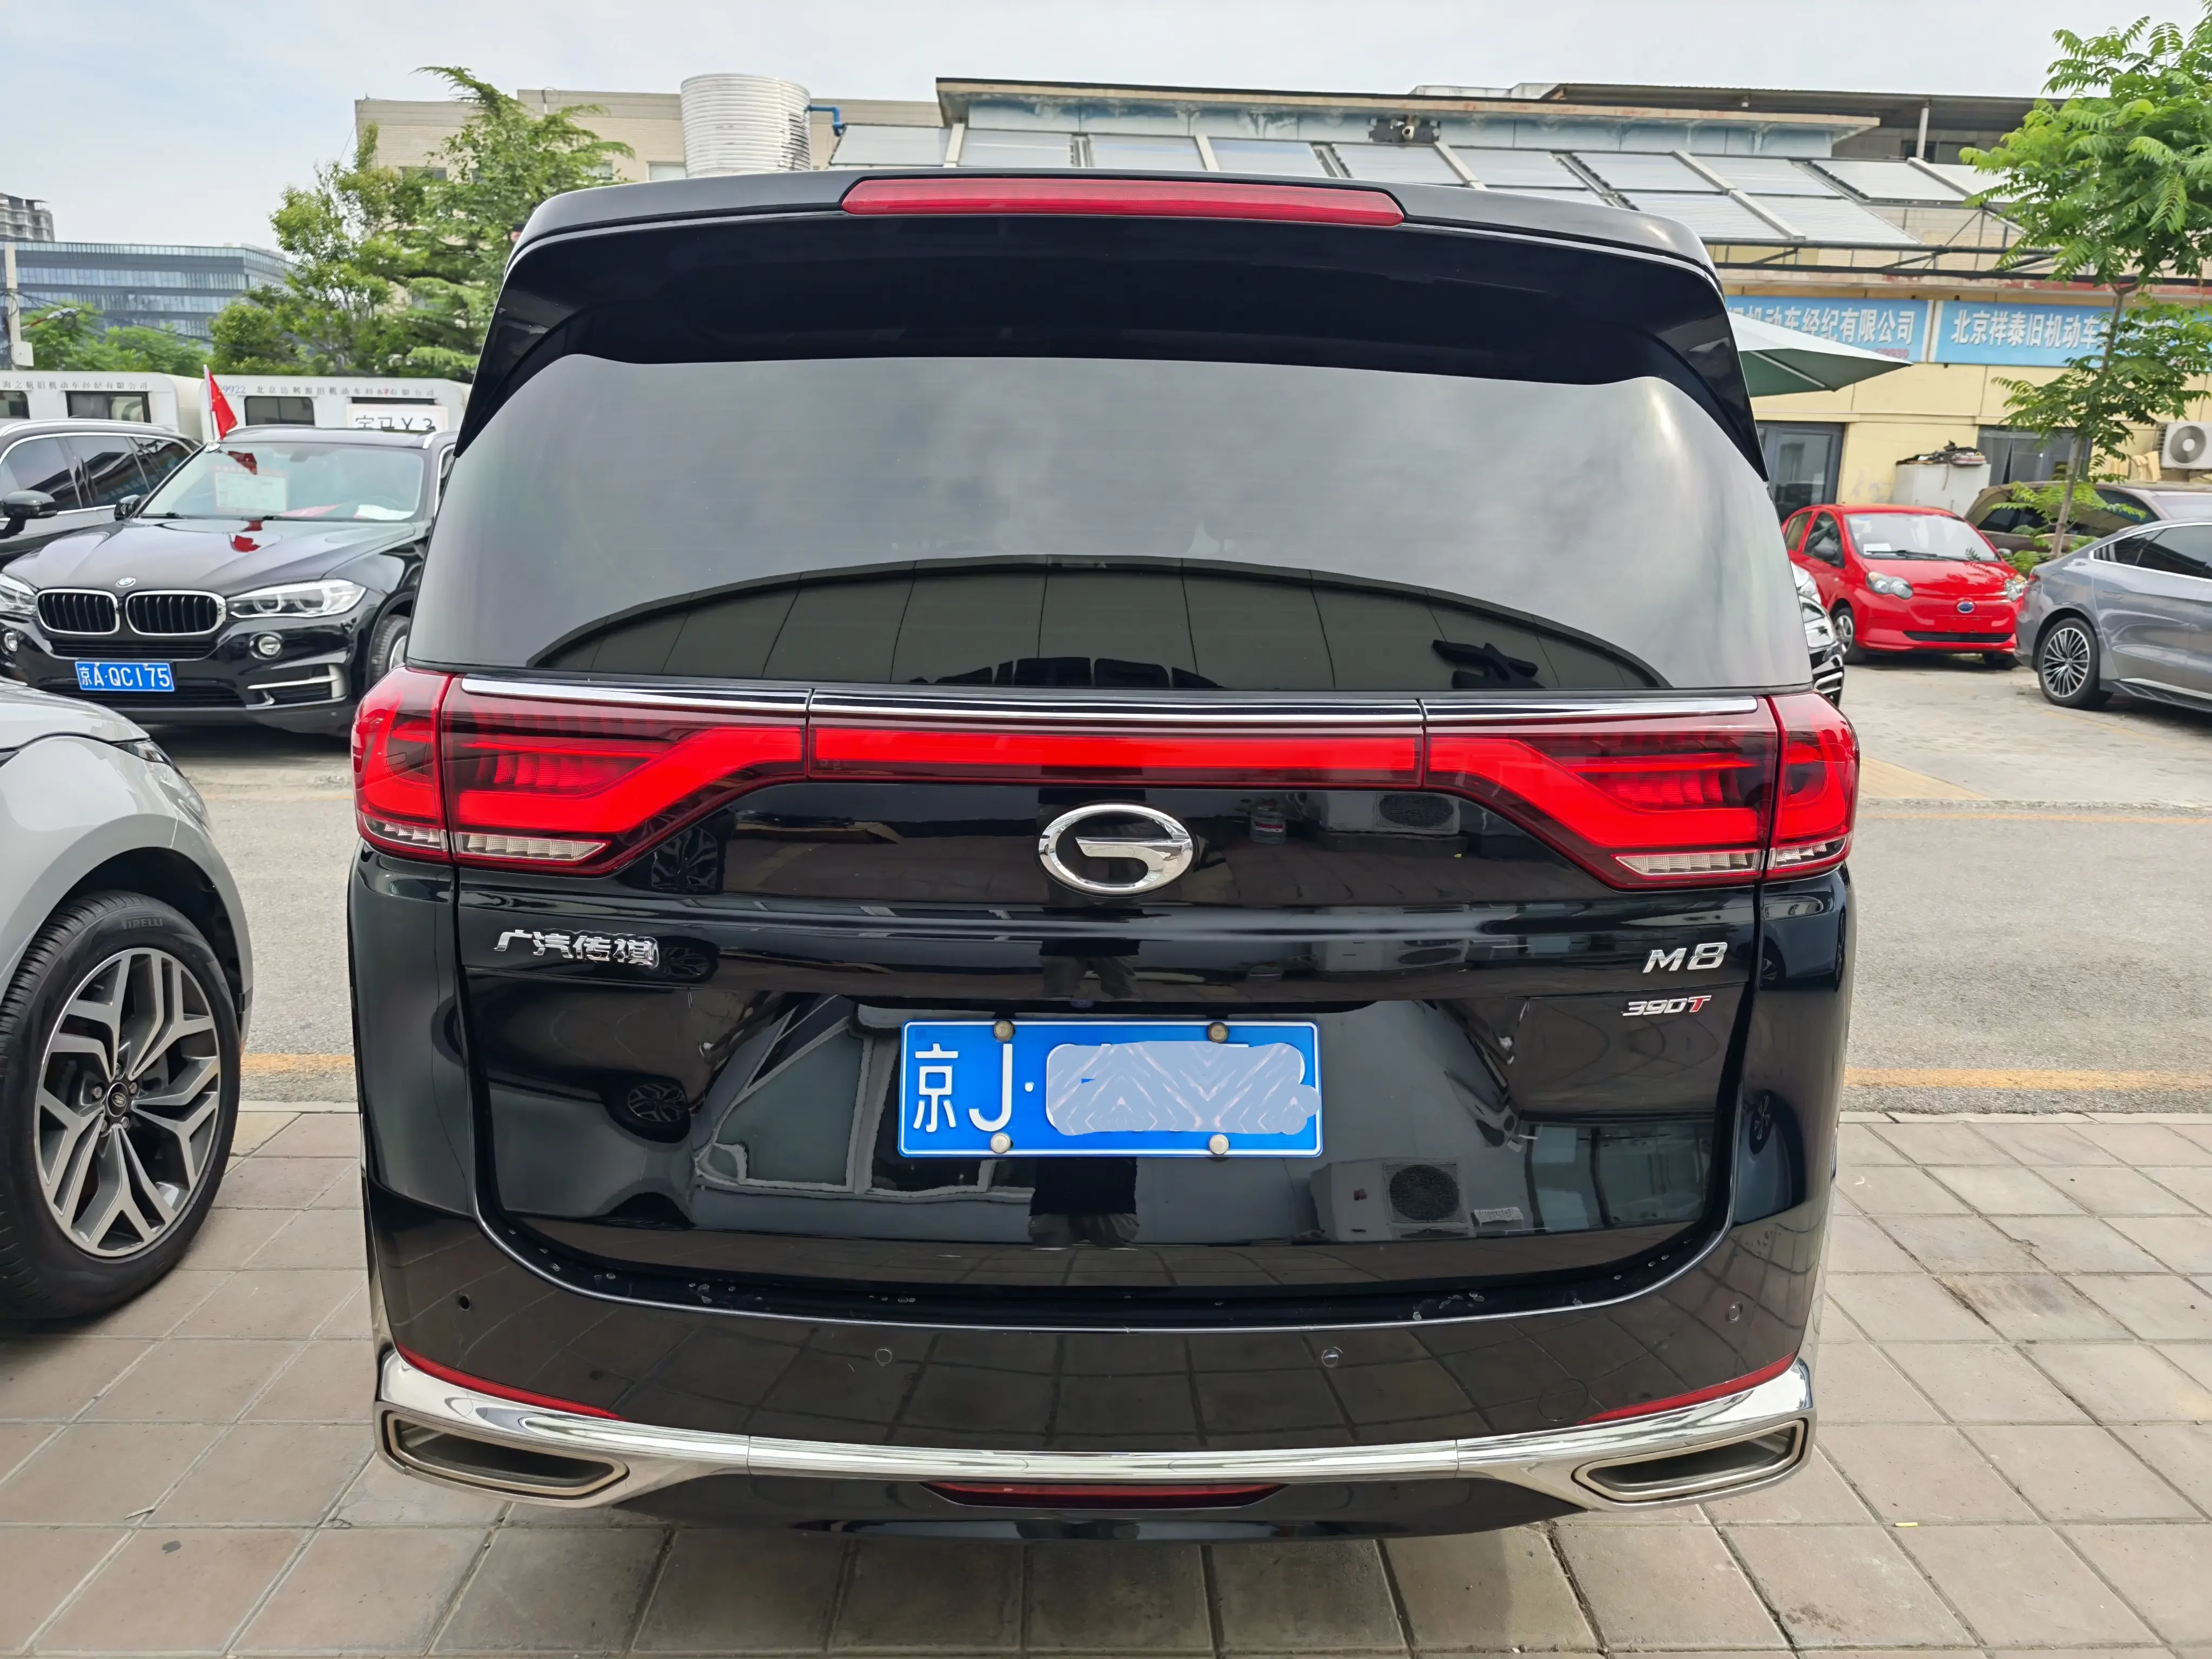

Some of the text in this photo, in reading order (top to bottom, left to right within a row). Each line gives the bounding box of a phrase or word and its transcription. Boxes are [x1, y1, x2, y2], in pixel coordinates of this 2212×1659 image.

[1729, 306, 1916, 345] 动车经纪有限公司
[494, 929, 655, 966] 广汽传祺
[1642, 942, 1728, 973] M8
[1622, 995, 1712, 1016] 390T
